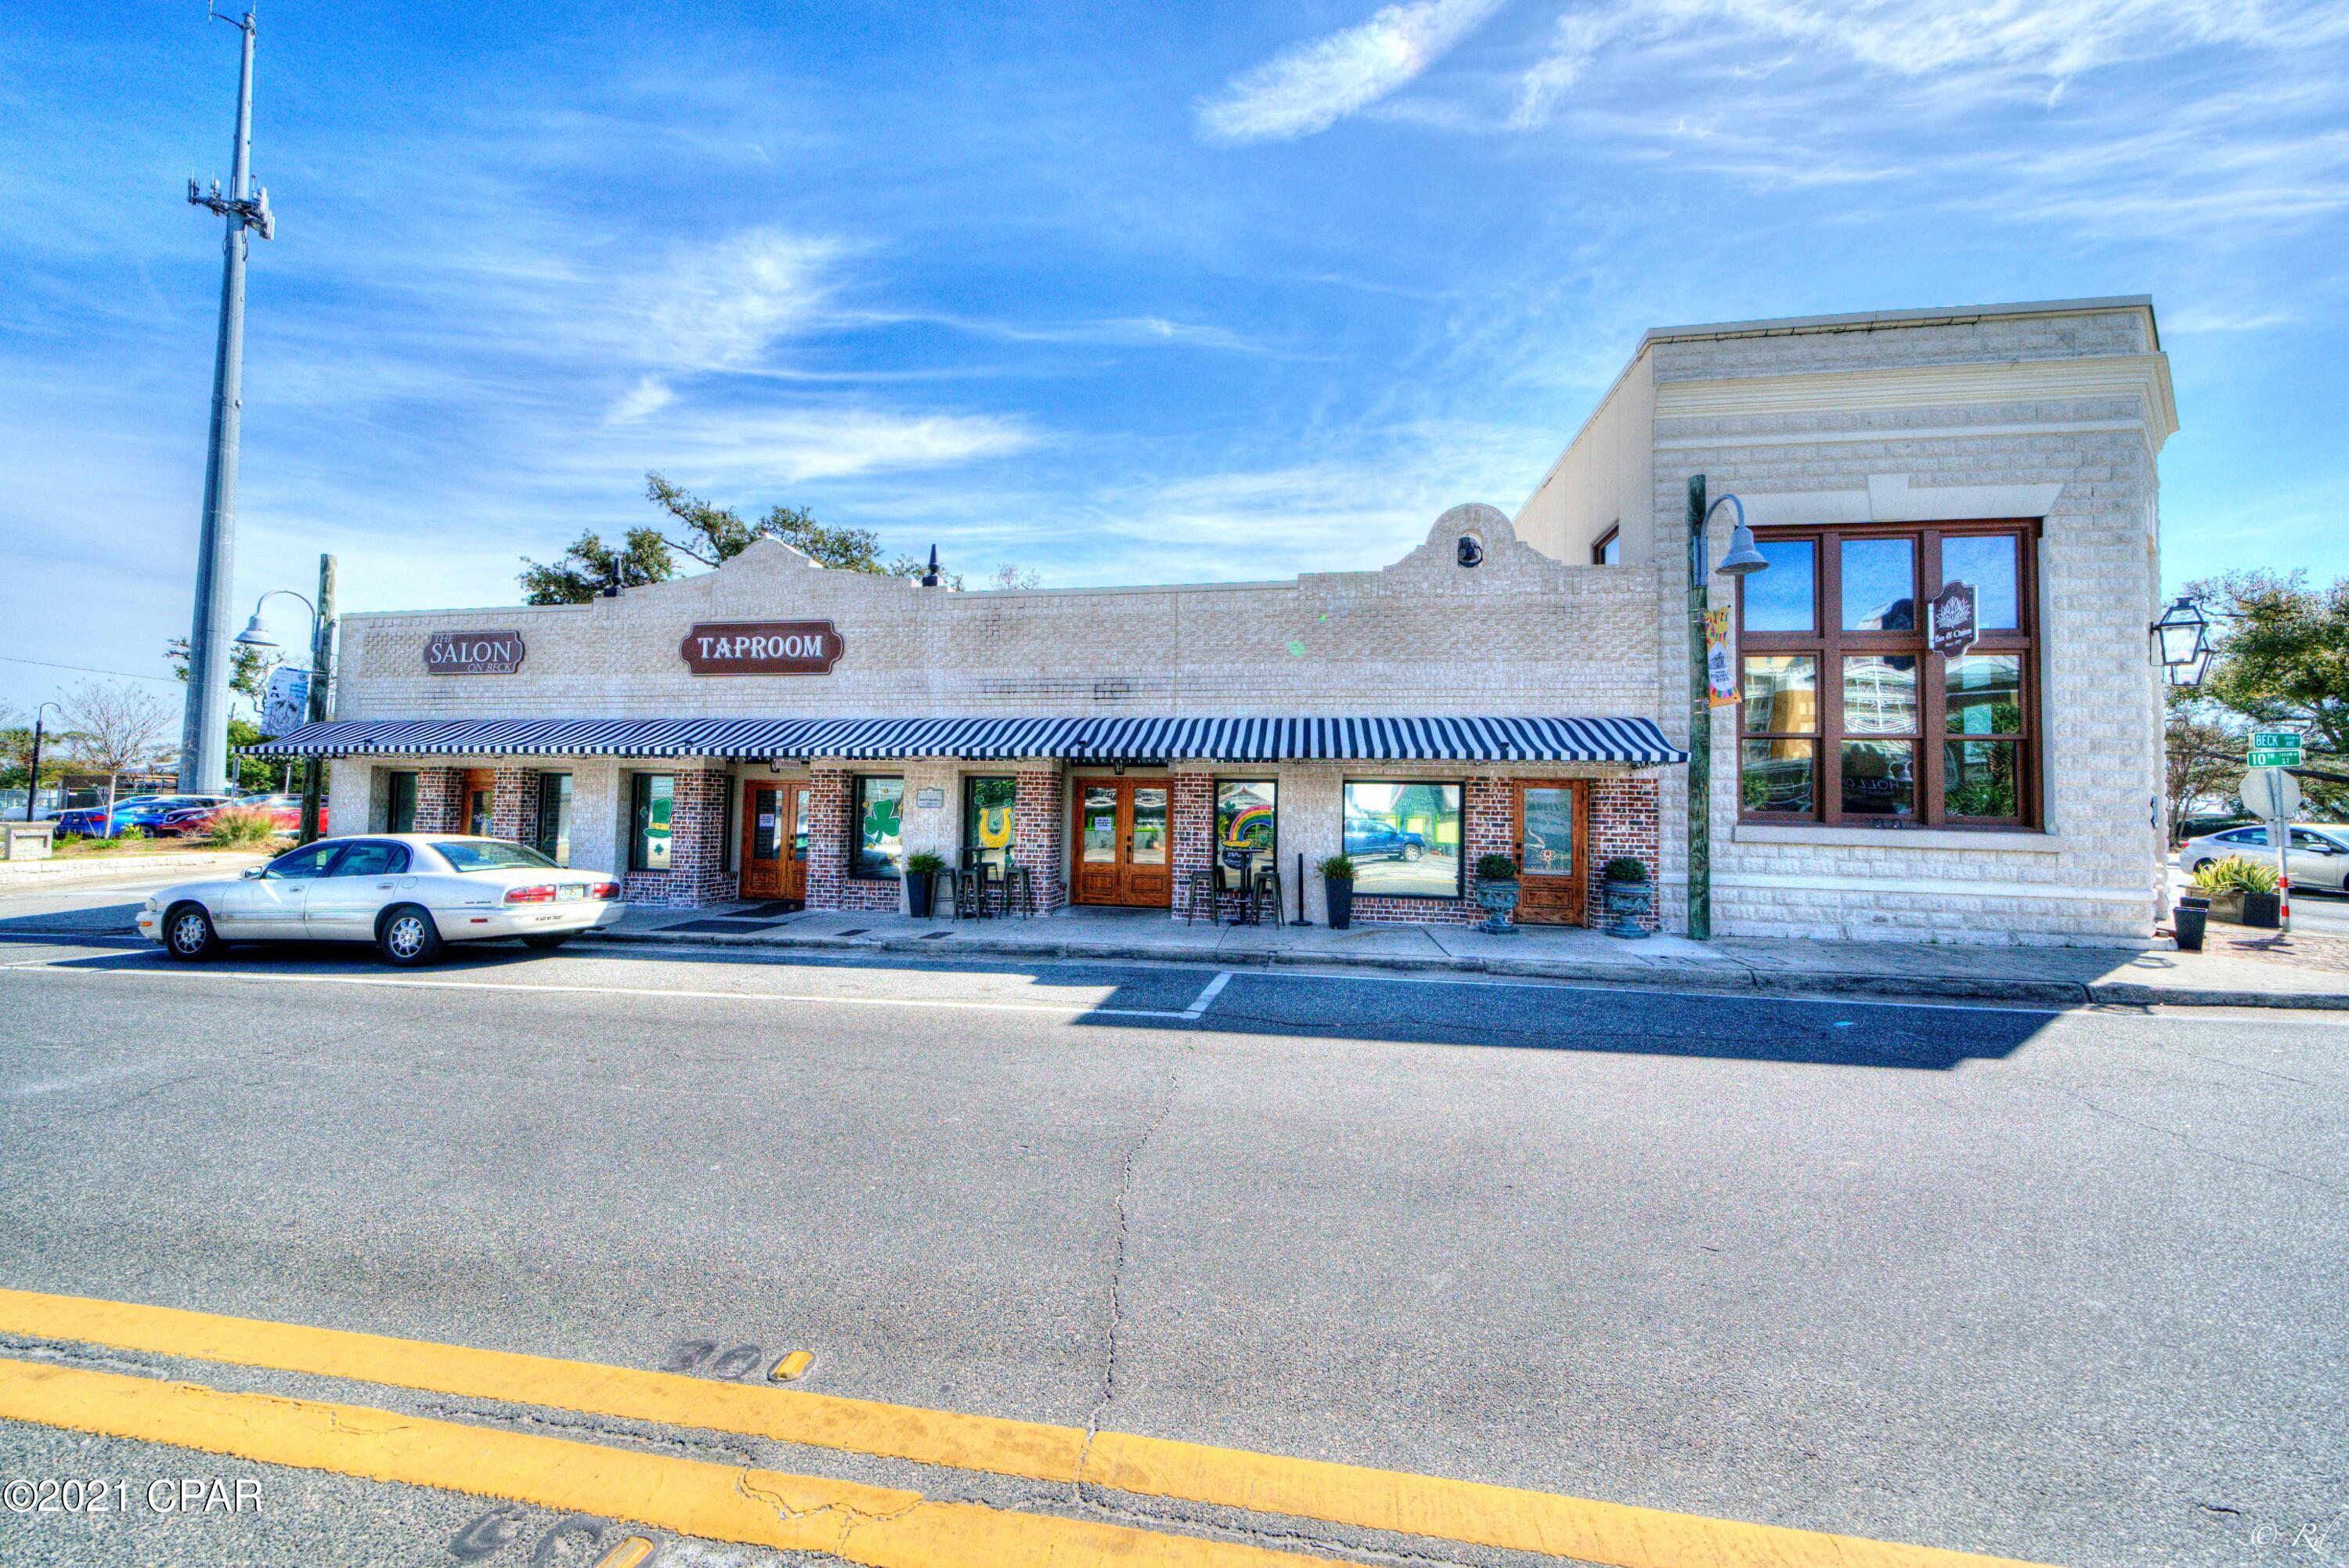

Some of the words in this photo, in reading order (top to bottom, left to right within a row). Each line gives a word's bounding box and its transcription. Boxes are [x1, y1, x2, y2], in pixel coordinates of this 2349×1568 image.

[431, 642, 512, 663] SALON
[697, 635, 824, 659] TAPROOM
[486, 663, 512, 672] BECK
[2256, 734, 2279, 747] BECK
